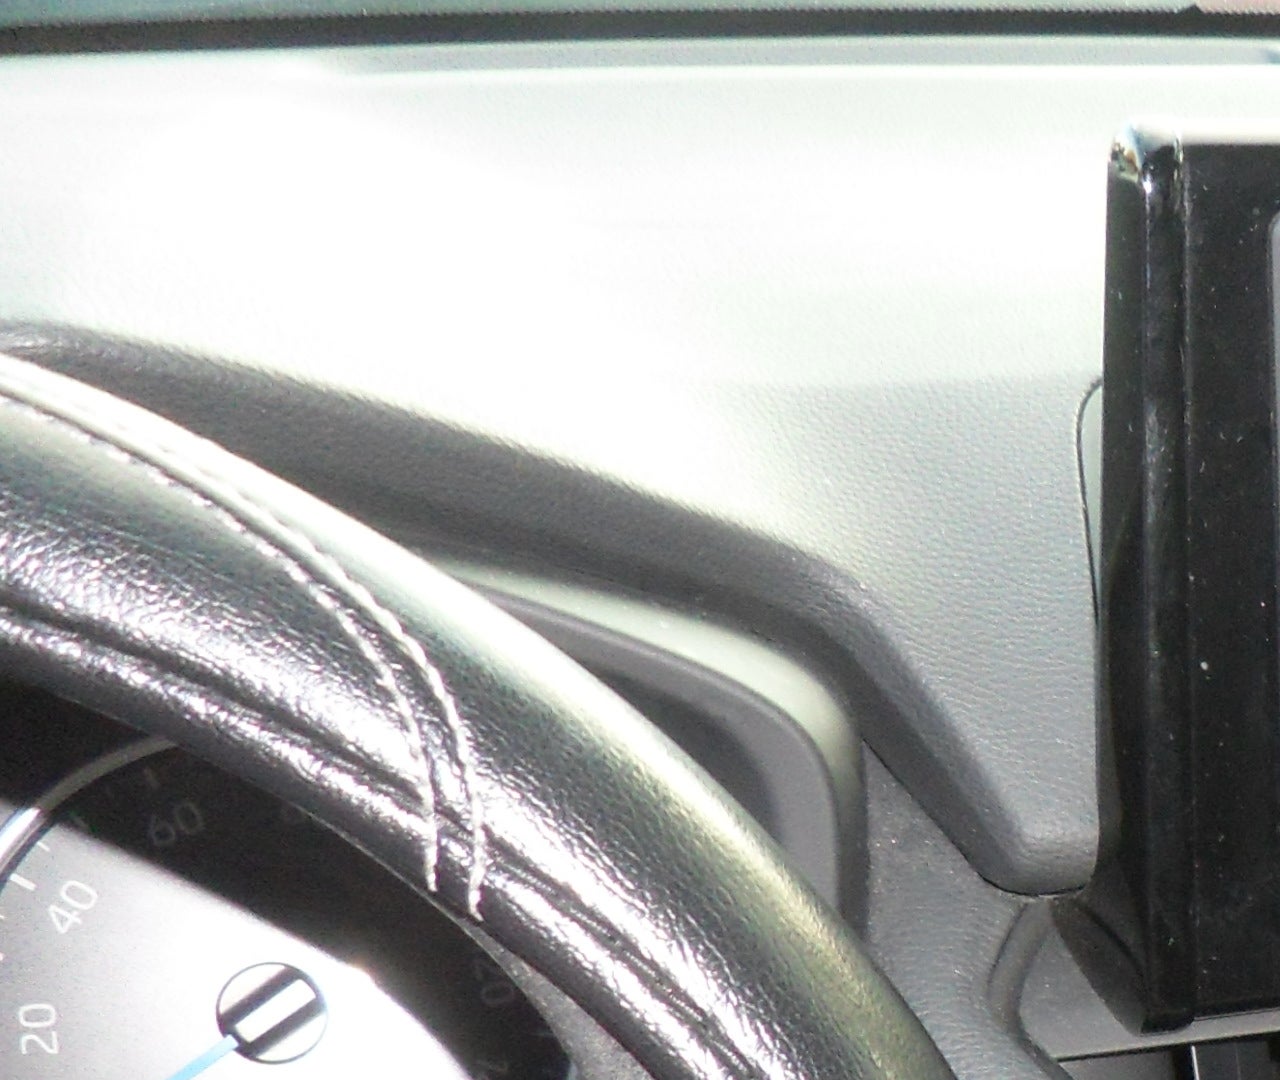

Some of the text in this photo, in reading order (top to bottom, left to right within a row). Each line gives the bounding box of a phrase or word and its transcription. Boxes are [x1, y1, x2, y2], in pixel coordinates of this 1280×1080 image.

[148, 799, 206, 849] 60
[48, 879, 98, 934] 40
[18, 1003, 59, 1055] 20
